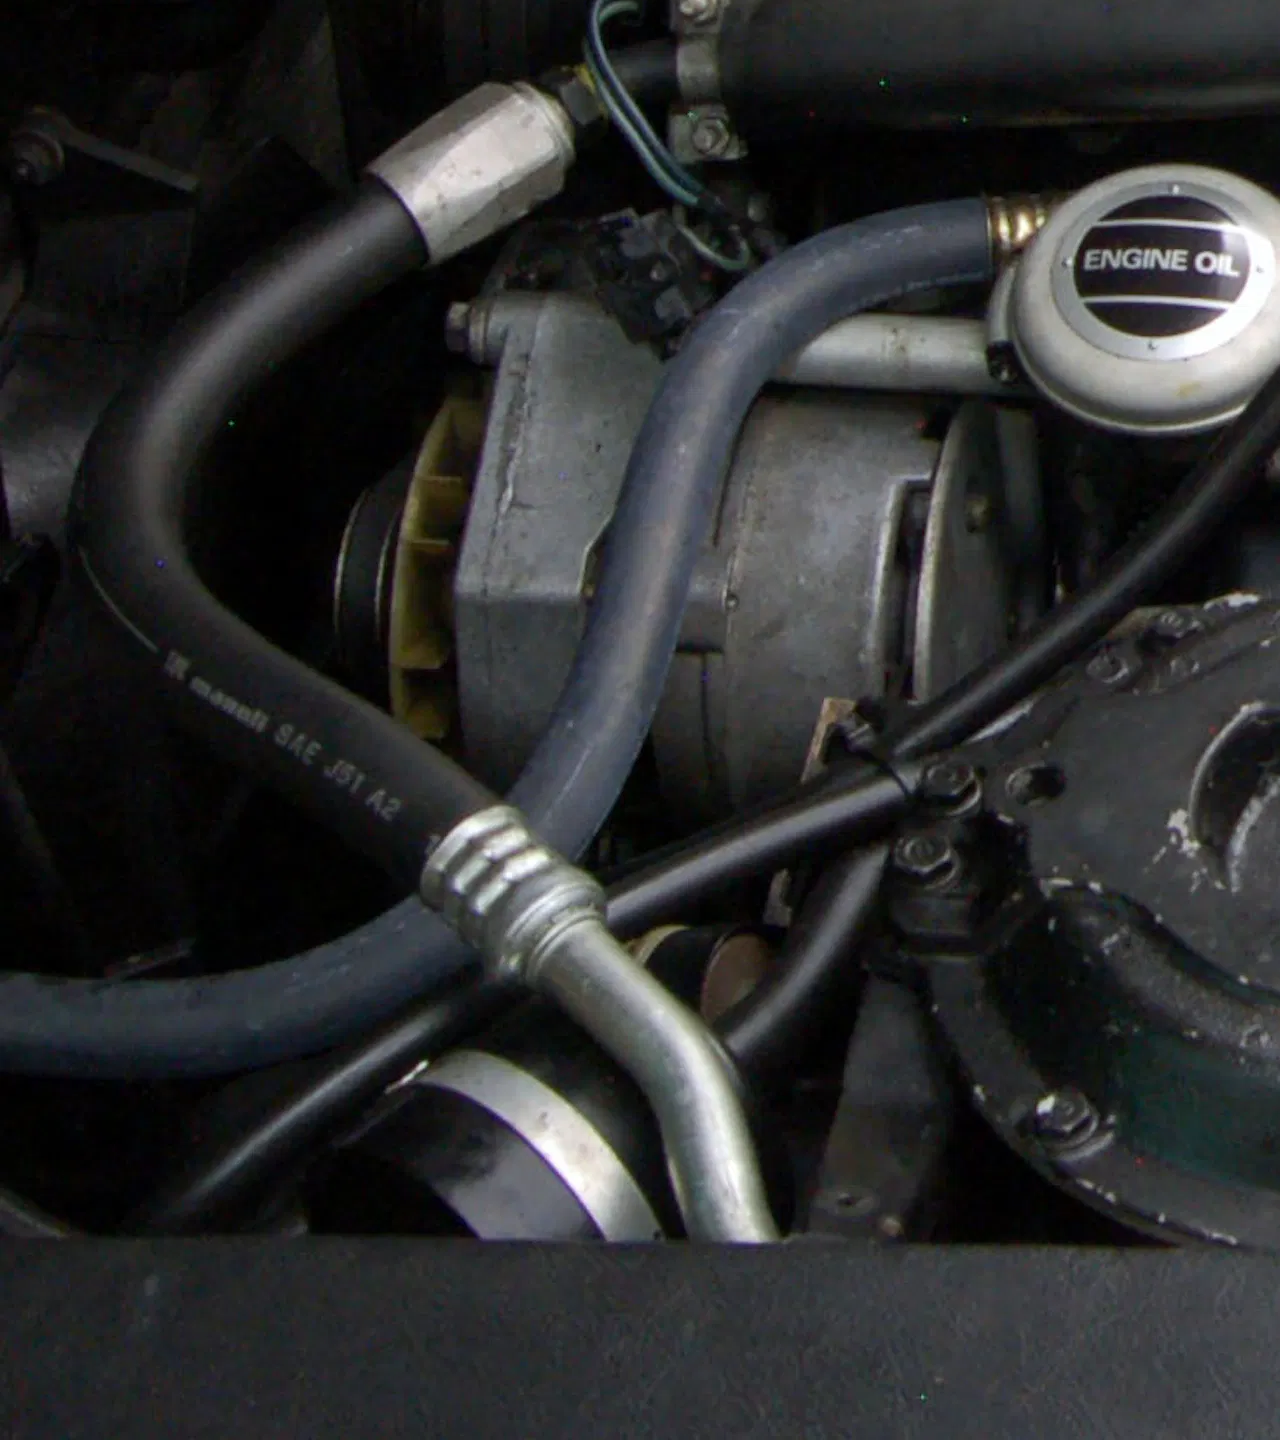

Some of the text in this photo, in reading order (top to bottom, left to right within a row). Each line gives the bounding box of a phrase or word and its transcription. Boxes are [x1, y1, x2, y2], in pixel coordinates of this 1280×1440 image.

[1083, 248, 1240, 278] ENGINE OIL
[274, 722, 322, 765] SAE
[366, 788, 403, 823] A2
